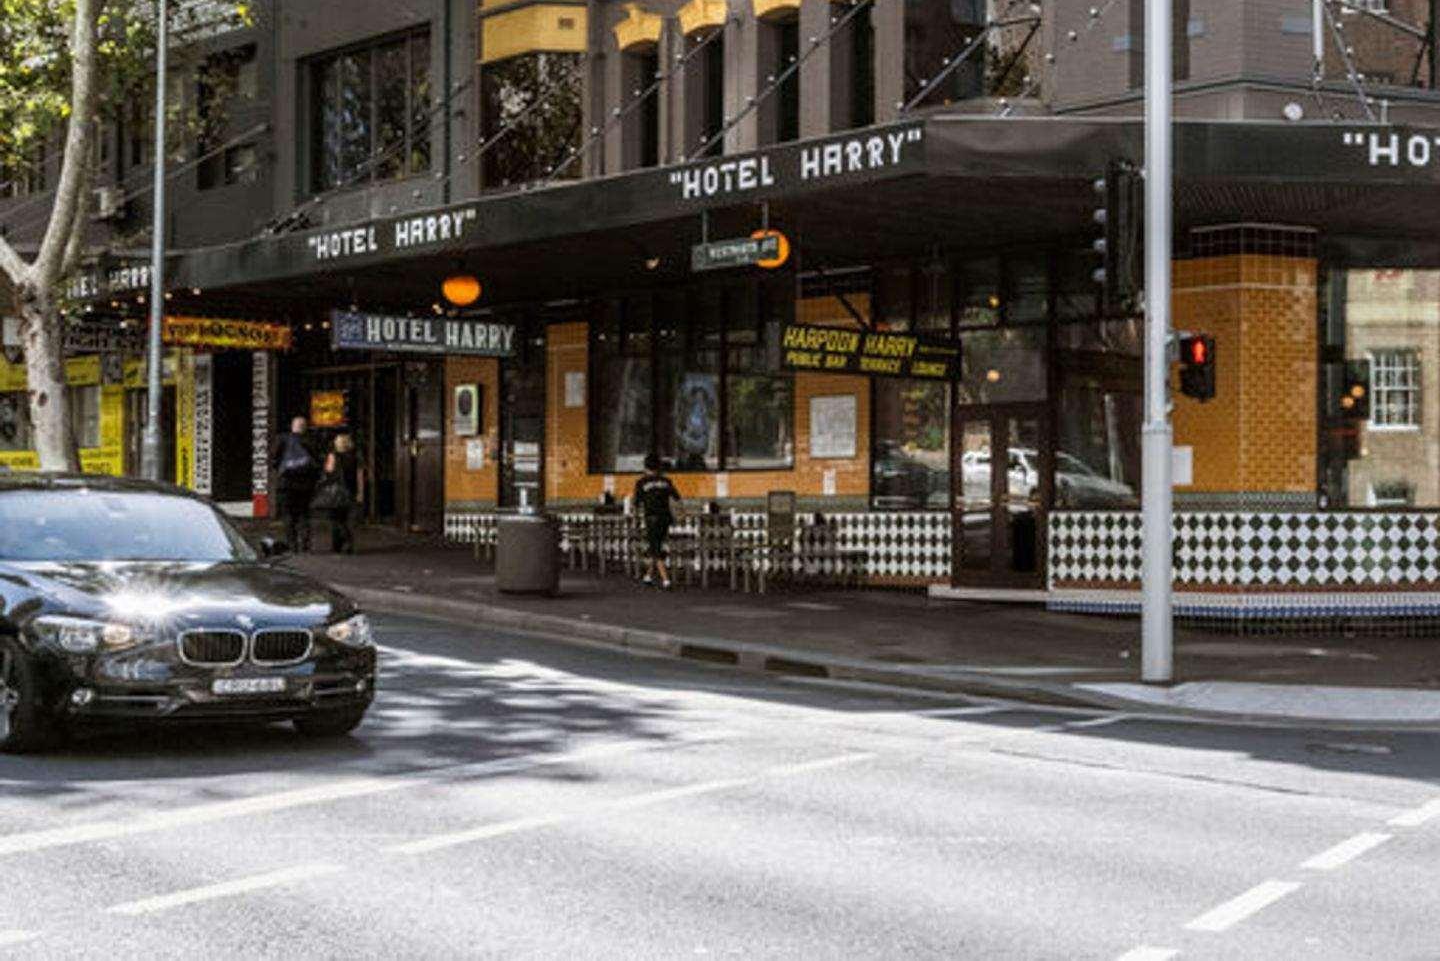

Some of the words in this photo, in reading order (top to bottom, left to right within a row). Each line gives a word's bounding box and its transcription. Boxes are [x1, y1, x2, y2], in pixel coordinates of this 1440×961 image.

[670, 155, 775, 199] "HOTEL
[800, 128, 922, 179] HARRY"
[308, 226, 378, 259] "HOTEL
[395, 209, 477, 247] HARRY"
[366, 316, 437, 343] HOTEL
[445, 320, 515, 351] HARRY
[863, 334, 917, 356] HARRY
